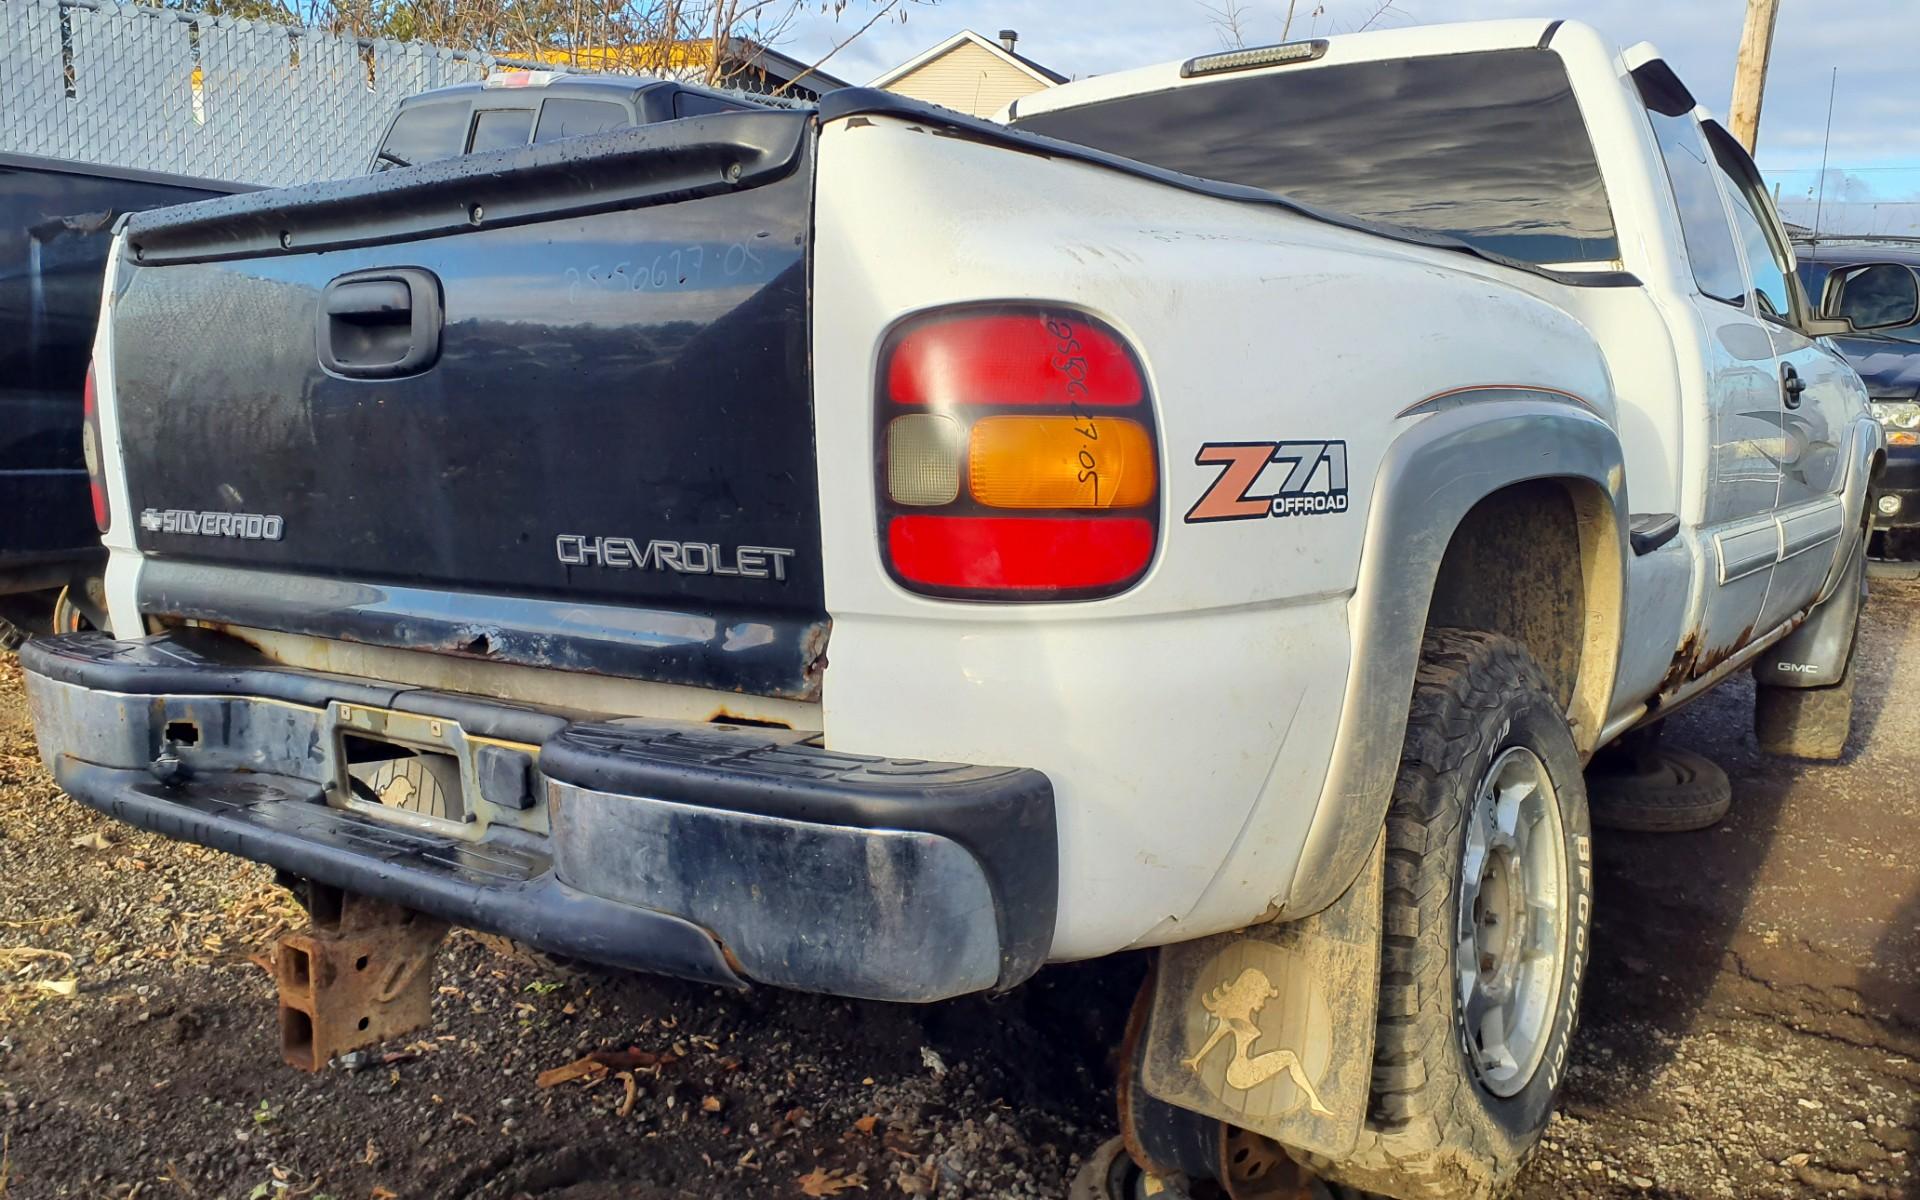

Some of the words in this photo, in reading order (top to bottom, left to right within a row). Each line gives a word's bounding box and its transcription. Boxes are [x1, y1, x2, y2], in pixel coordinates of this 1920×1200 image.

[1184, 440, 1349, 524] Z71
[1271, 494, 1348, 517] OFFROAD
[162, 510, 283, 540] SILVERADO
[555, 534, 796, 581] CHEVROLET
[1777, 662, 1819, 674] GMC
[1547, 836, 1590, 1089] BFGoodrich
